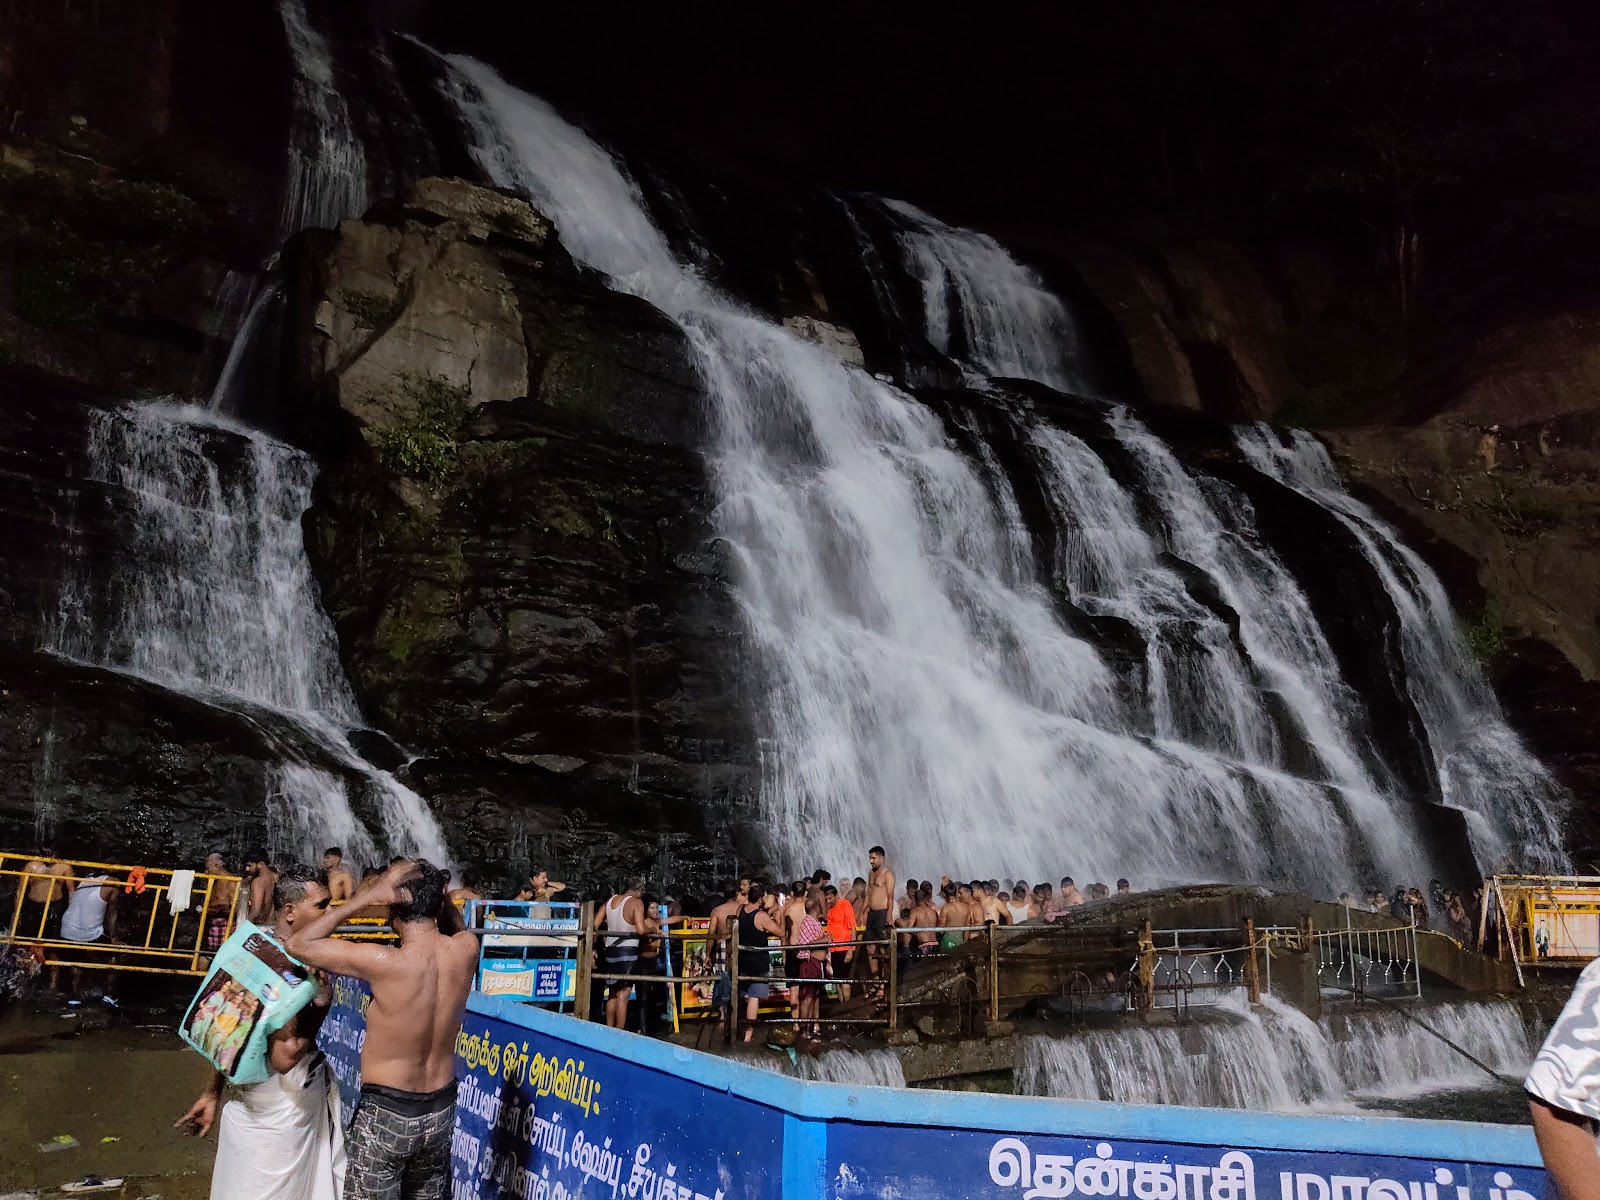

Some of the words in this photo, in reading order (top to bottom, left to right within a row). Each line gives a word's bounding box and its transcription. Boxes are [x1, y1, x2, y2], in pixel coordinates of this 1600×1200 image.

[455, 1023, 500, 1076] களுக்கு
[457, 1074, 521, 1136] ளிப்பவர்கள்
[988, 1137, 1256, 1200] தென்காசி
